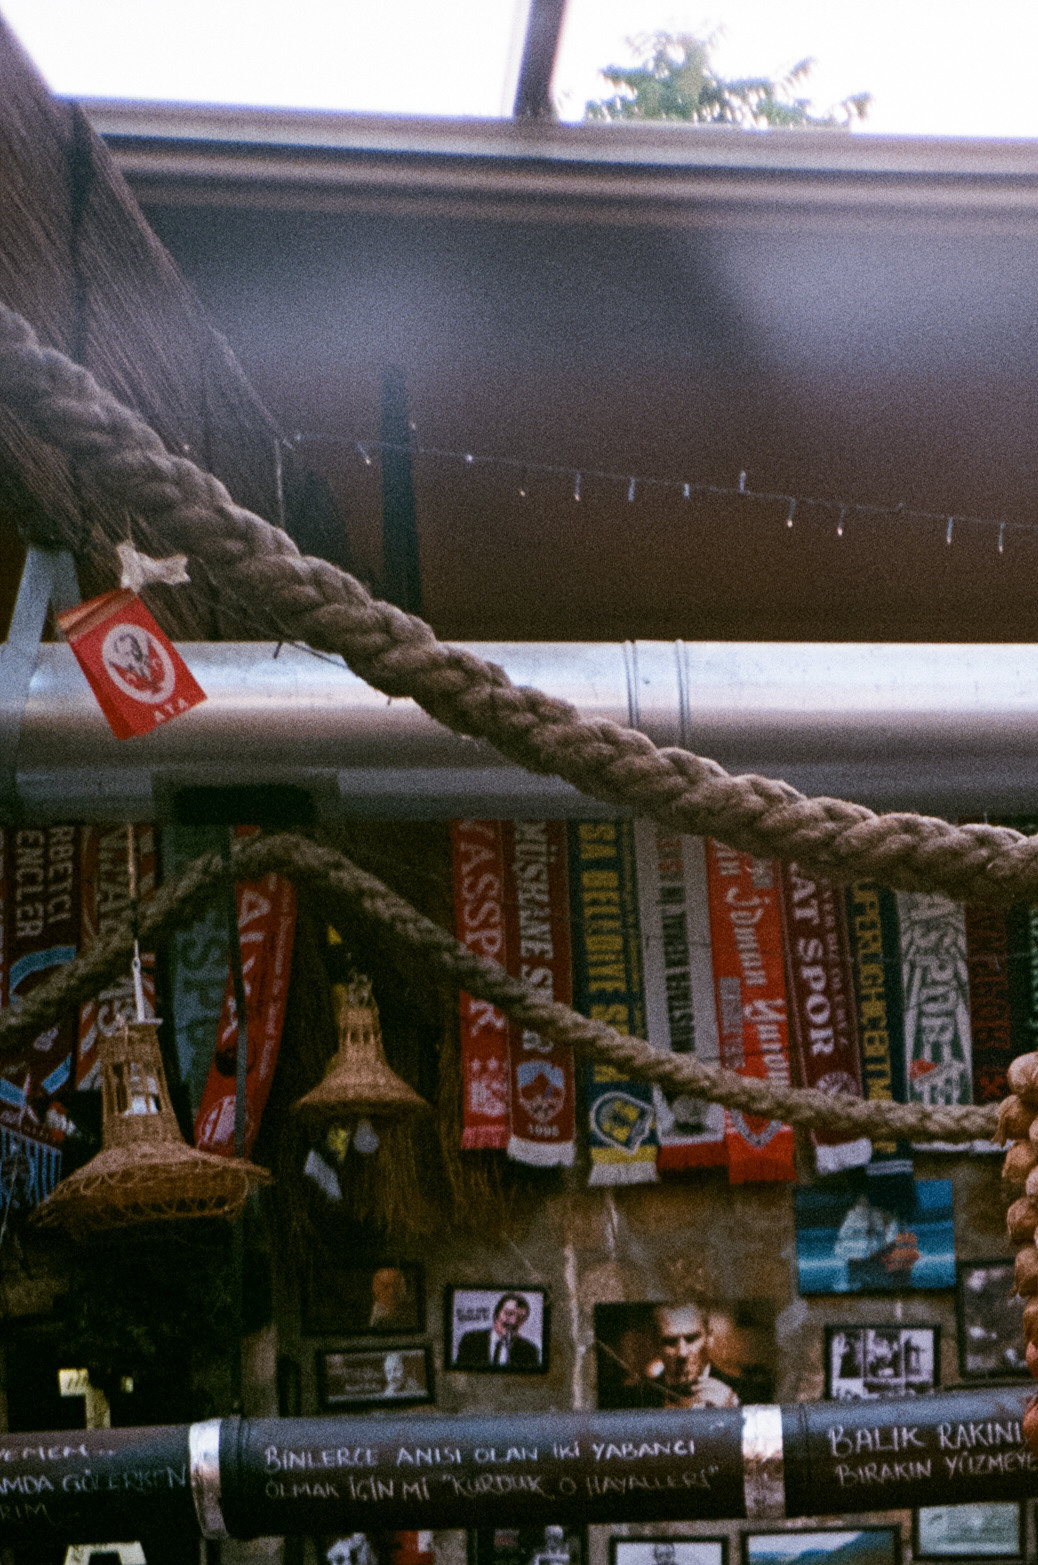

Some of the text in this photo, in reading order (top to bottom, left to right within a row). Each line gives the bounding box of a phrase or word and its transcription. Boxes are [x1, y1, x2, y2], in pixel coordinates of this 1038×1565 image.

[15, 828, 45, 939] ENCLER
[797, 936, 836, 1058] SPOR
[394, 1445, 461, 1468] ANISI
[472, 1445, 538, 1464] OLAN
[591, 1439, 695, 1462] YABANCI
[825, 1424, 925, 1458] BALIK
[937, 1421, 1022, 1450] RAKINI
[264, 1480, 338, 1500] OLMAK
